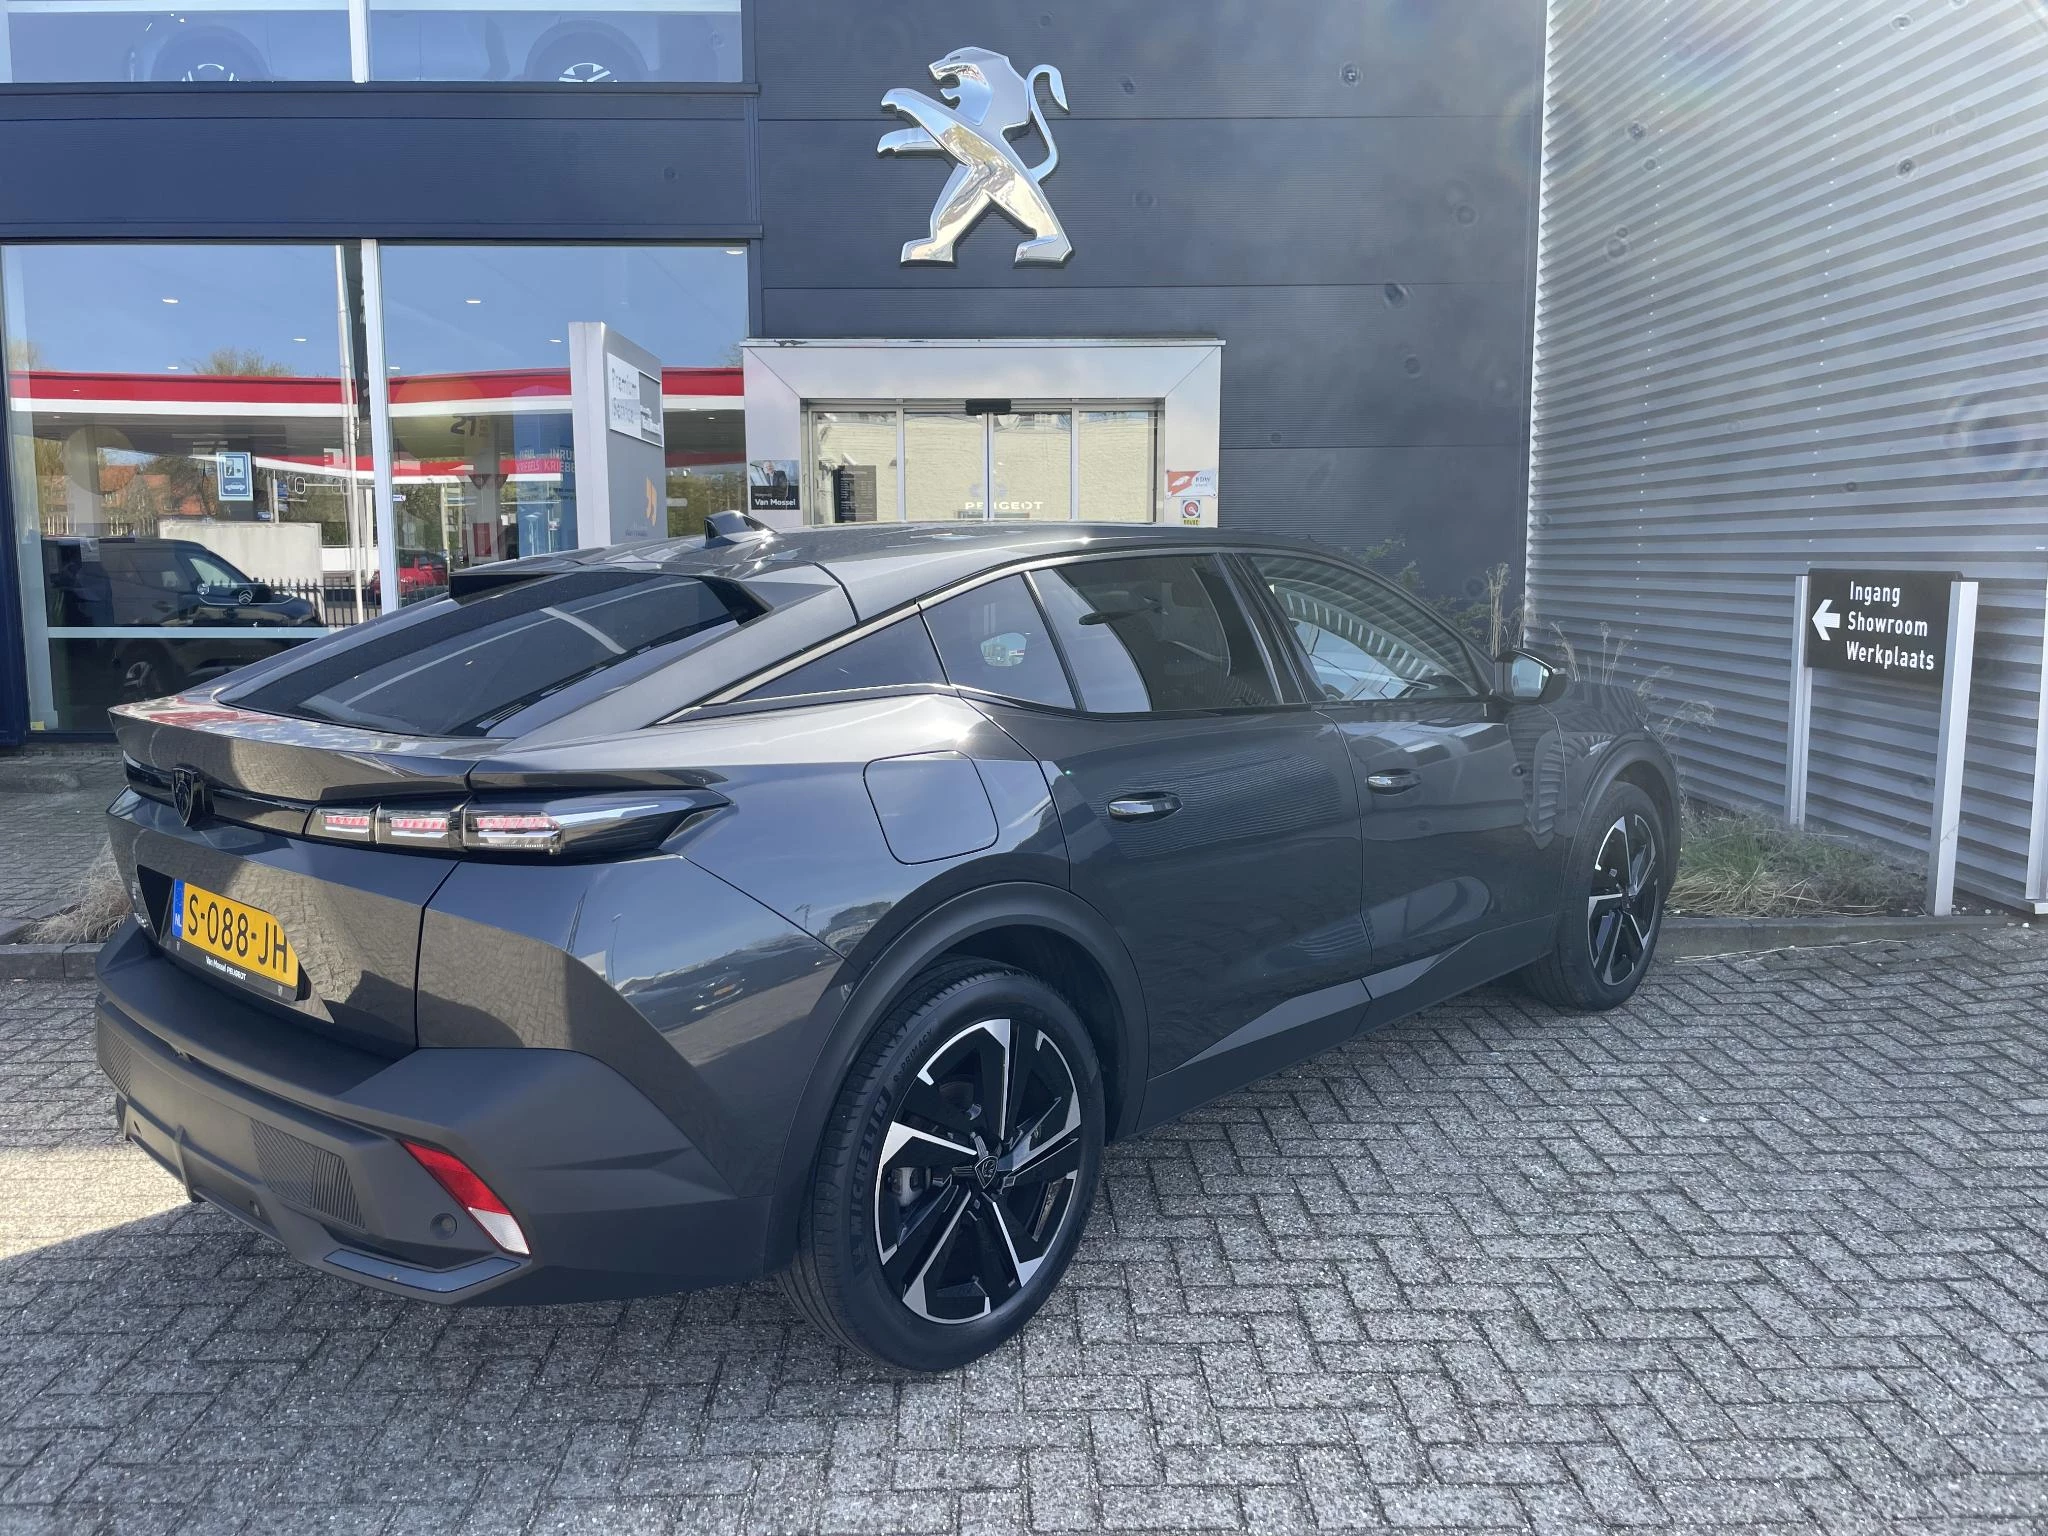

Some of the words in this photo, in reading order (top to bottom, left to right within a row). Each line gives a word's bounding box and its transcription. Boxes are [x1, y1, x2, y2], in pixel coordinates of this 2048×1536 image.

[755, 498, 769, 506] Van
[770, 498, 796, 506] Mossel
[1850, 581, 1901, 607] Ingang
[1847, 611, 1928, 637] Showroom
[1846, 640, 1934, 670] Werkplaats
[188, 894, 288, 974] S-088-JH
[226, 966, 247, 981] PEUGEOT
[850, 1090, 890, 1236] MICHELIN
